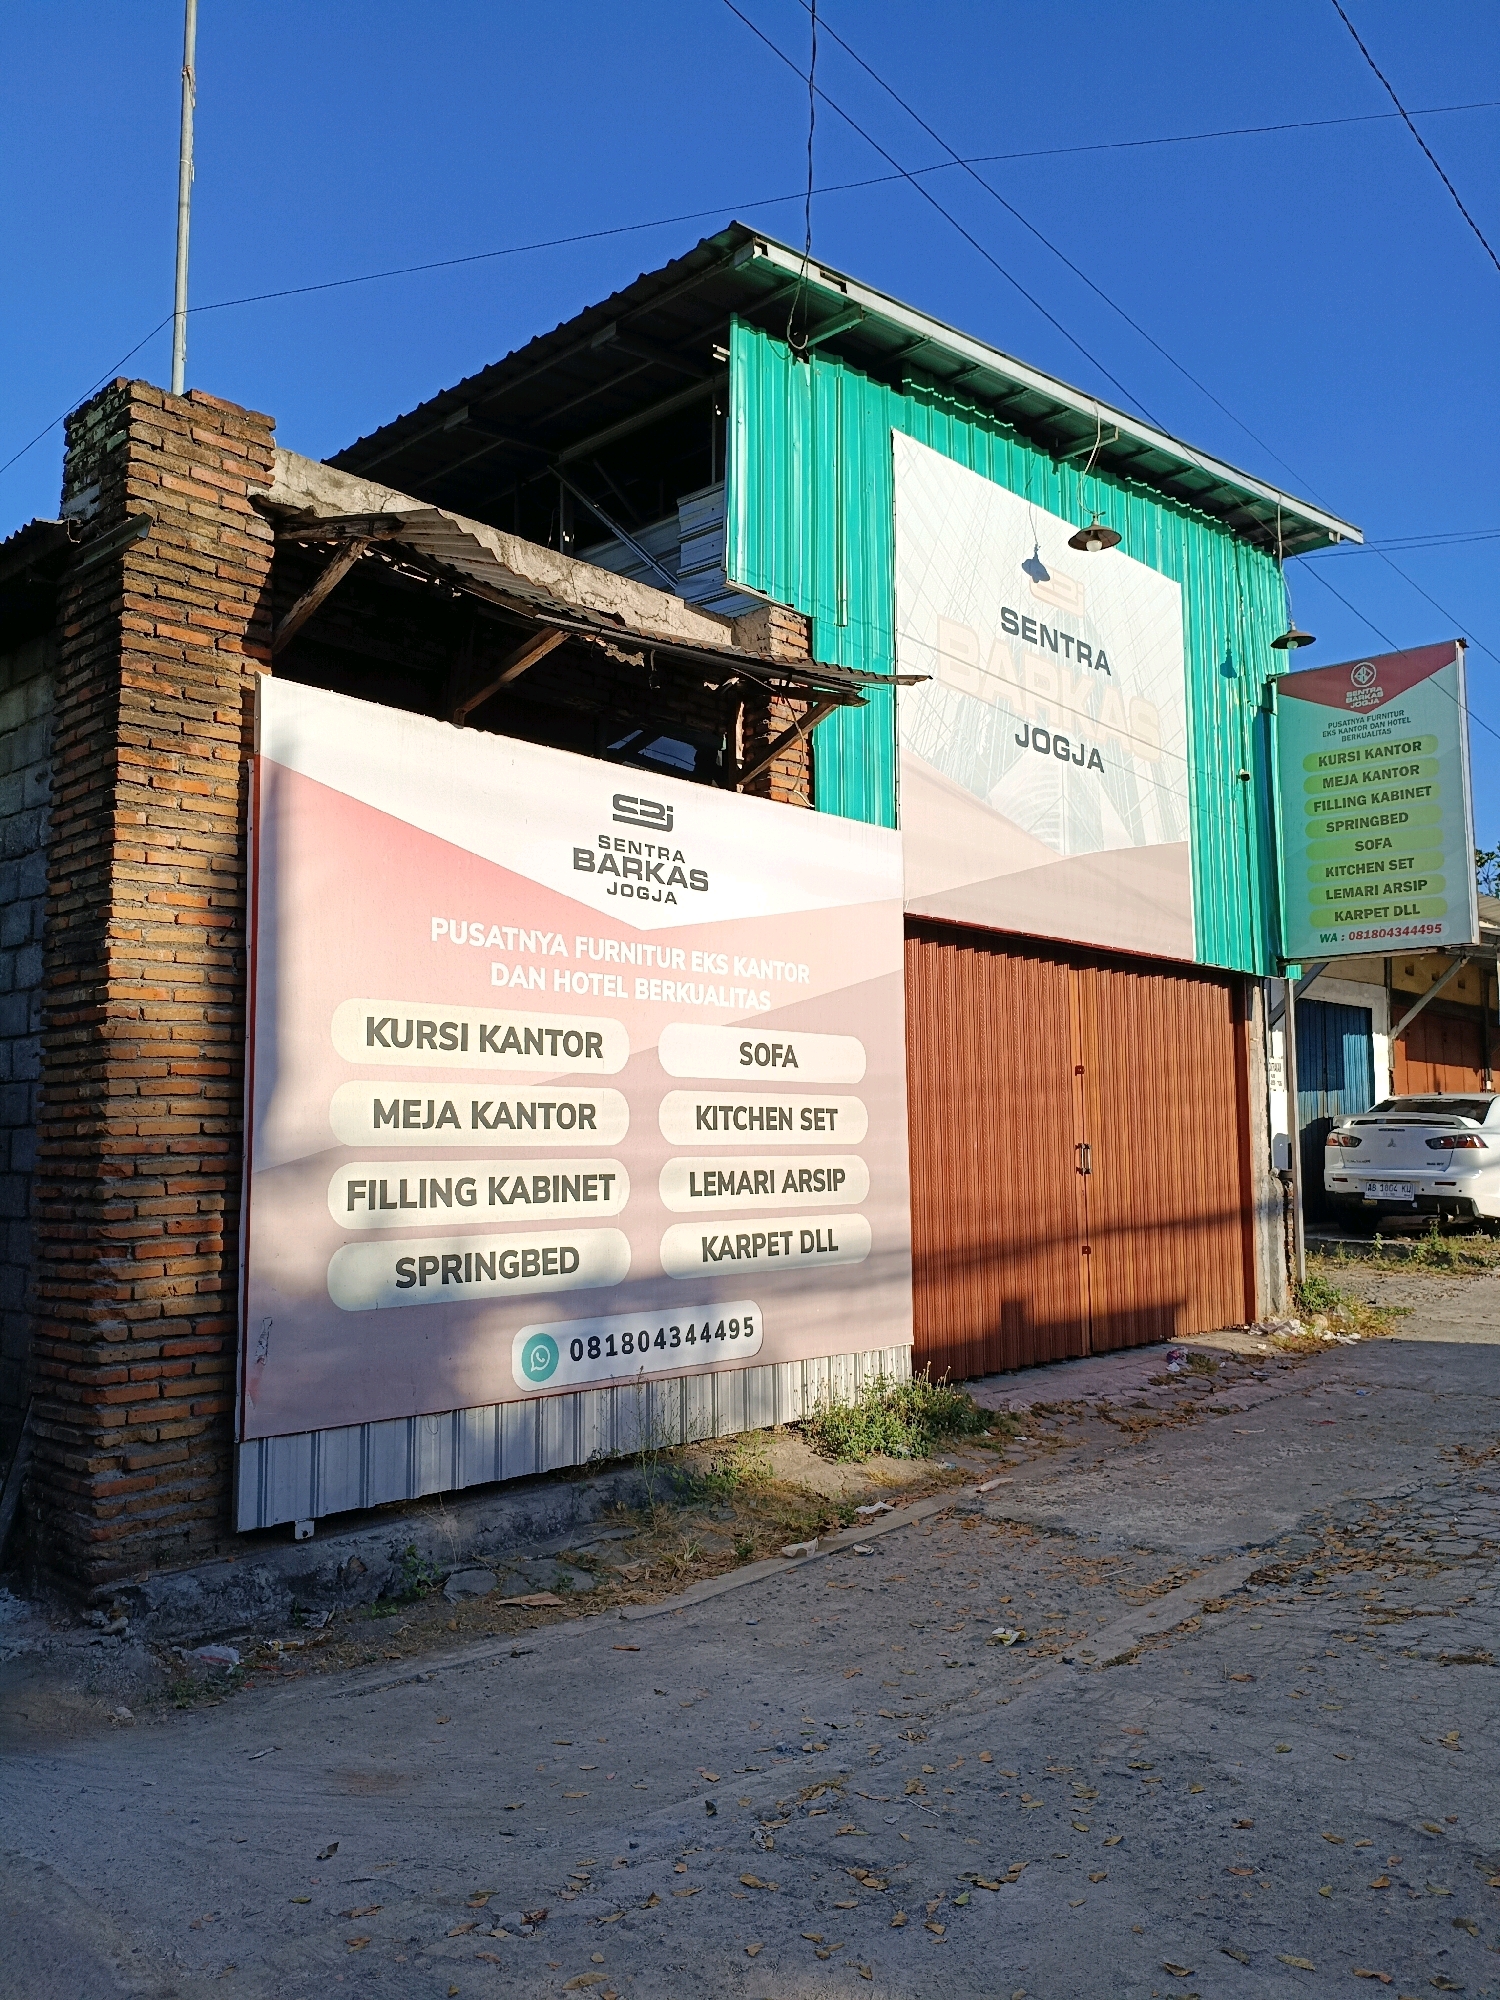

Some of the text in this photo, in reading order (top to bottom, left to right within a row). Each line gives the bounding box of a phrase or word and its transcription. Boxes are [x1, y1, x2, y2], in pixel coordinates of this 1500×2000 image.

[1001, 606, 1112, 676] SENTRA
[936, 613, 1161, 764] BARKAS
[1350, 698, 1379, 708] JOGJA
[1322, 717, 1411, 738] EKS KANTOR DAN HOTEL
[1328, 710, 1405, 729] PUSATNYA FURNITUR
[1014, 723, 1105, 774] JOGJA
[1341, 728, 1392, 742] BERKUALITAS
[1318, 740, 1422, 767] KURSI KANTOR
[1322, 764, 1420, 789] MEJA KANTOR
[1313, 785, 1432, 812] FILLING KABINET
[1325, 812, 1409, 833] SPRINGBED
[598, 834, 685, 864] SENTRA
[1355, 837, 1392, 852] SOFA
[573, 847, 709, 892] BARKAS
[1325, 857, 1415, 878] KITCHEN SET
[606, 882, 677, 905] JOGJA
[1325, 879, 1428, 900] LEMARI ARSIP
[1334, 904, 1421, 922] KARPET DLL
[1319, 933, 1338, 943] WA
[1348, 923, 1443, 941] 081804344495
[430, 916, 811, 985] PUSATNYA FURNITUR EKS KANTOR
[490, 962, 772, 1011] DAN HOTEL BERKUALITAS
[366, 1016, 604, 1059] KURSI KANTOR
[739, 1041, 799, 1069] SOFA
[373, 1098, 597, 1130] MEJA KANTOR
[696, 1104, 839, 1132] KITCHEN SET
[347, 1173, 616, 1212] FILLING KABINET
[689, 1168, 846, 1197] LEMARI ARSIP
[701, 1228, 839, 1263] KARPET DLL
[395, 1246, 580, 1289] SPRINGBED
[569, 1316, 755, 1362] 081804344495
